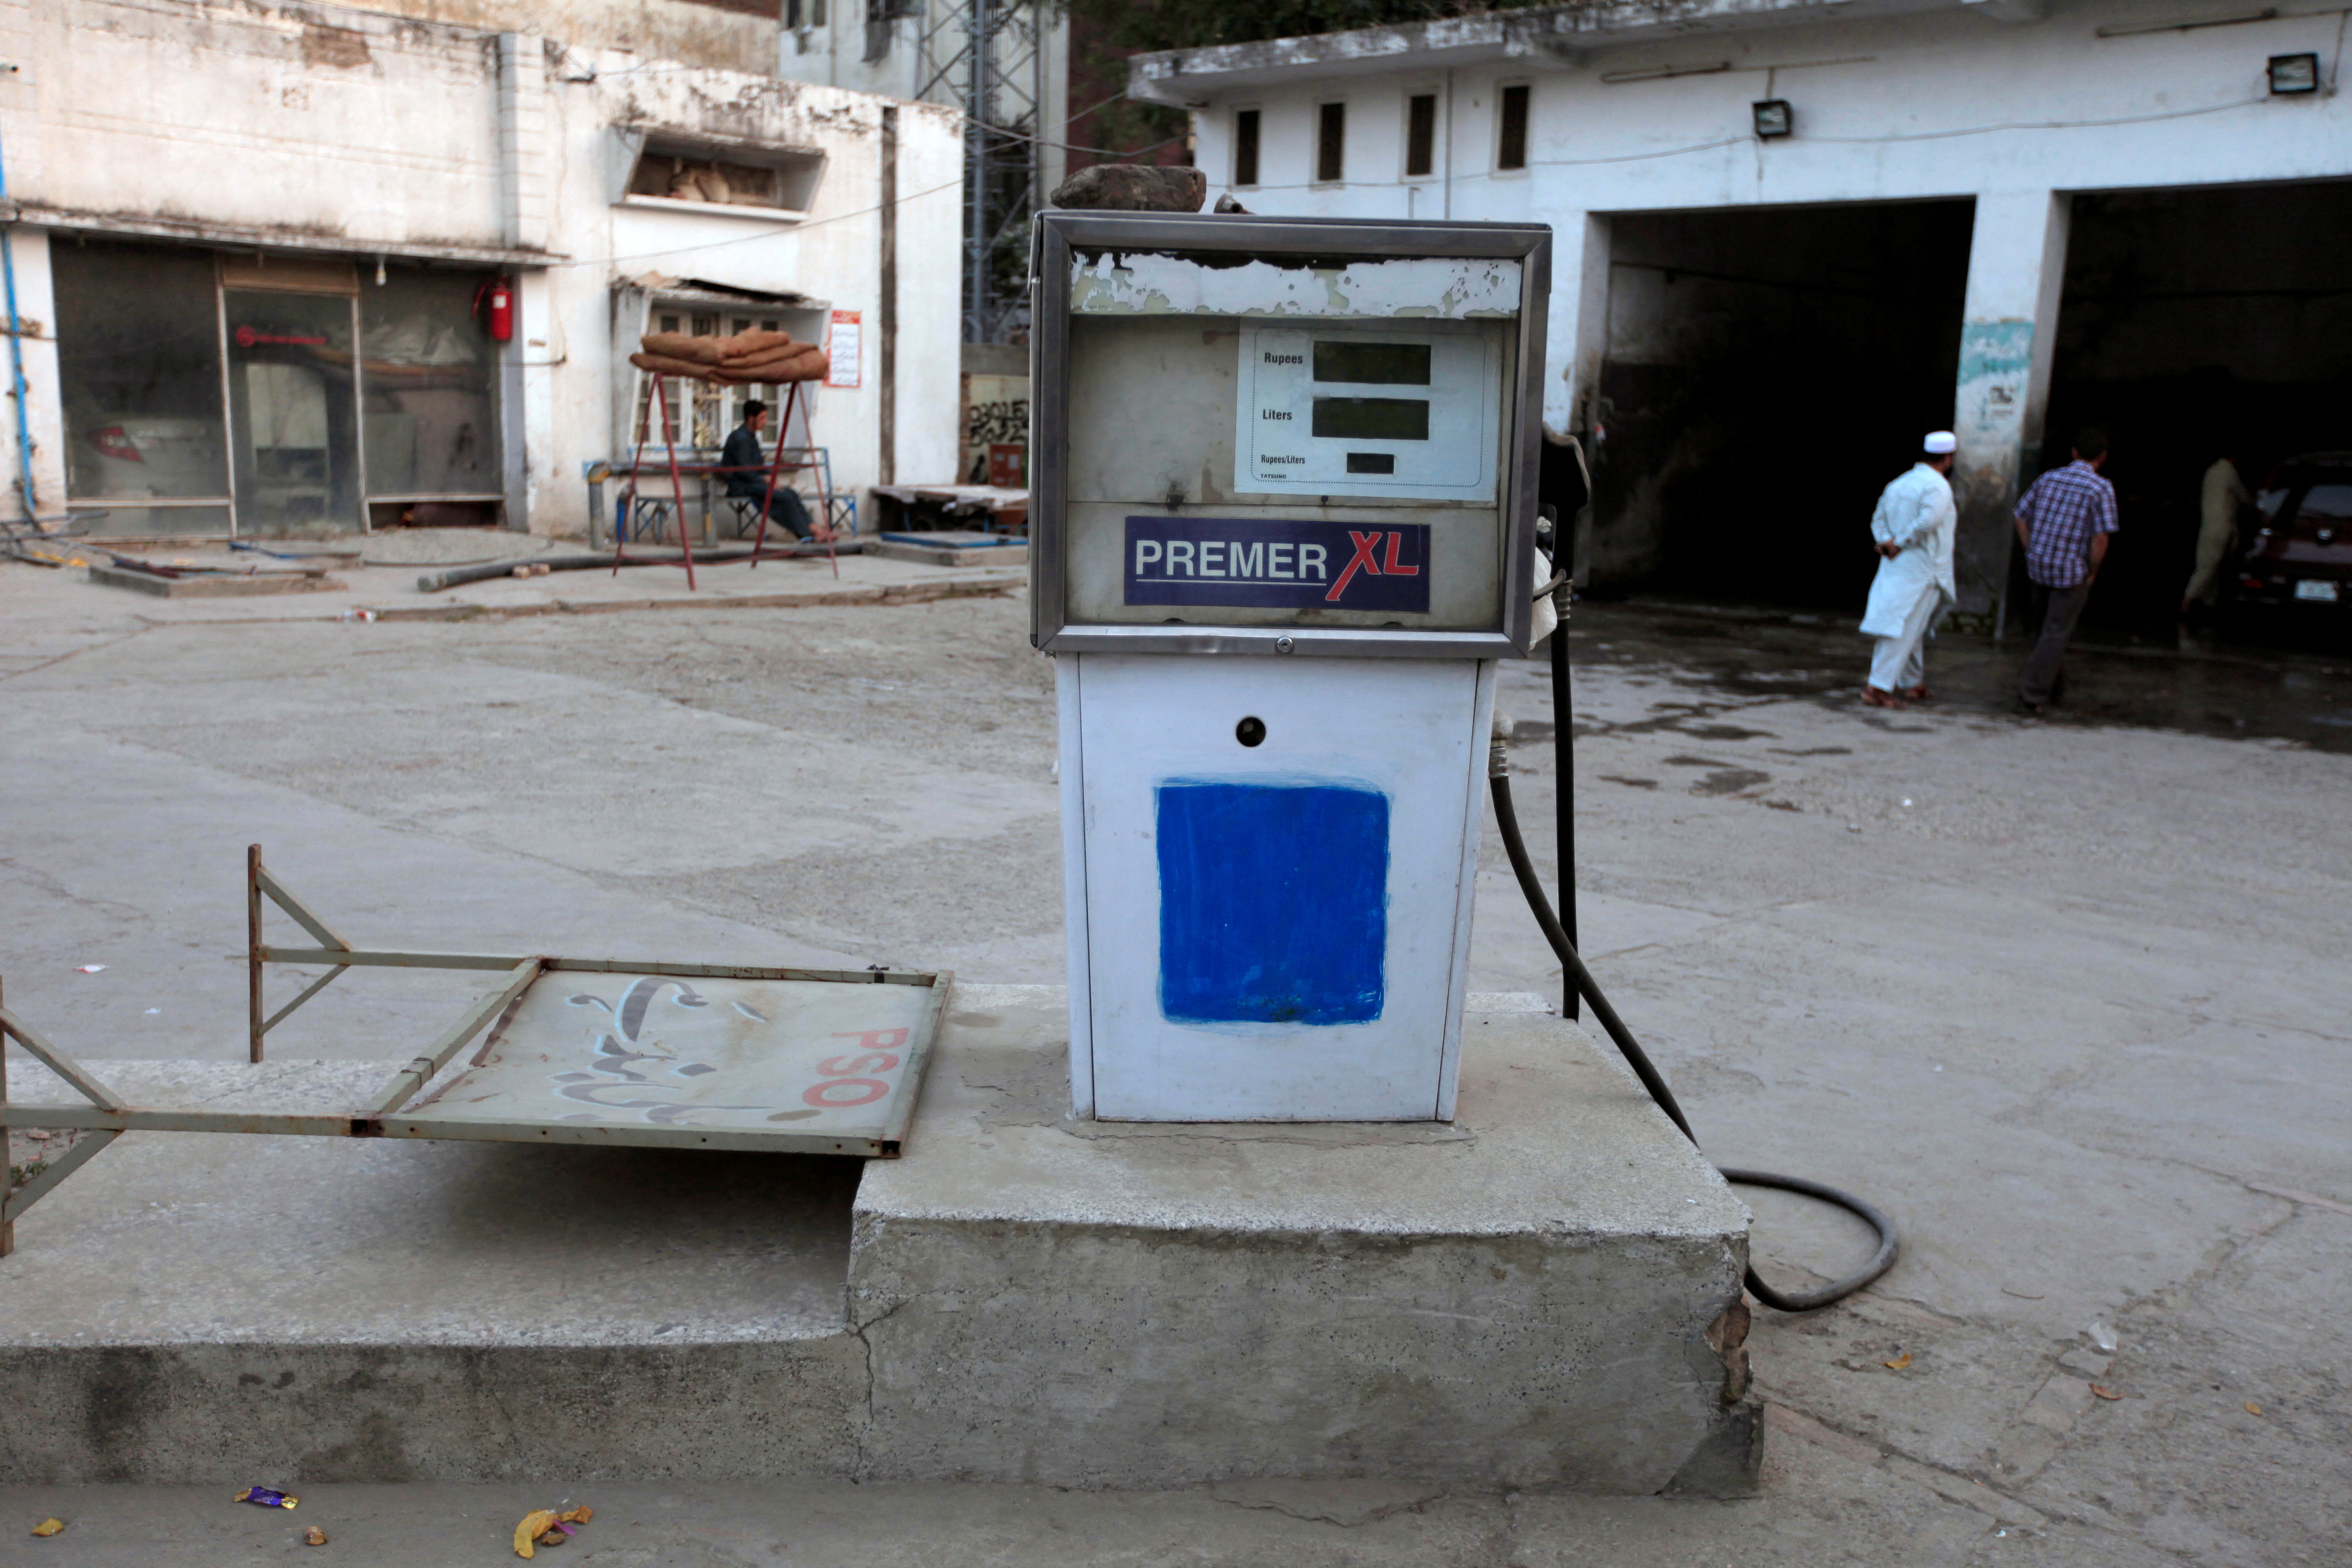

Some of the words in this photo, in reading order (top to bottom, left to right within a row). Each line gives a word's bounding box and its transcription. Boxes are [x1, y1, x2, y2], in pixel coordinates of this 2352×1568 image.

[1264, 352, 1303, 366] Rupees
[1263, 409, 1292, 420] Liters
[1261, 454, 1305, 465] Rupees/Liters
[1136, 540, 1327, 579] PREMER
[1325, 531, 1419, 601] XL
[802, 1027, 910, 1108] PSO
